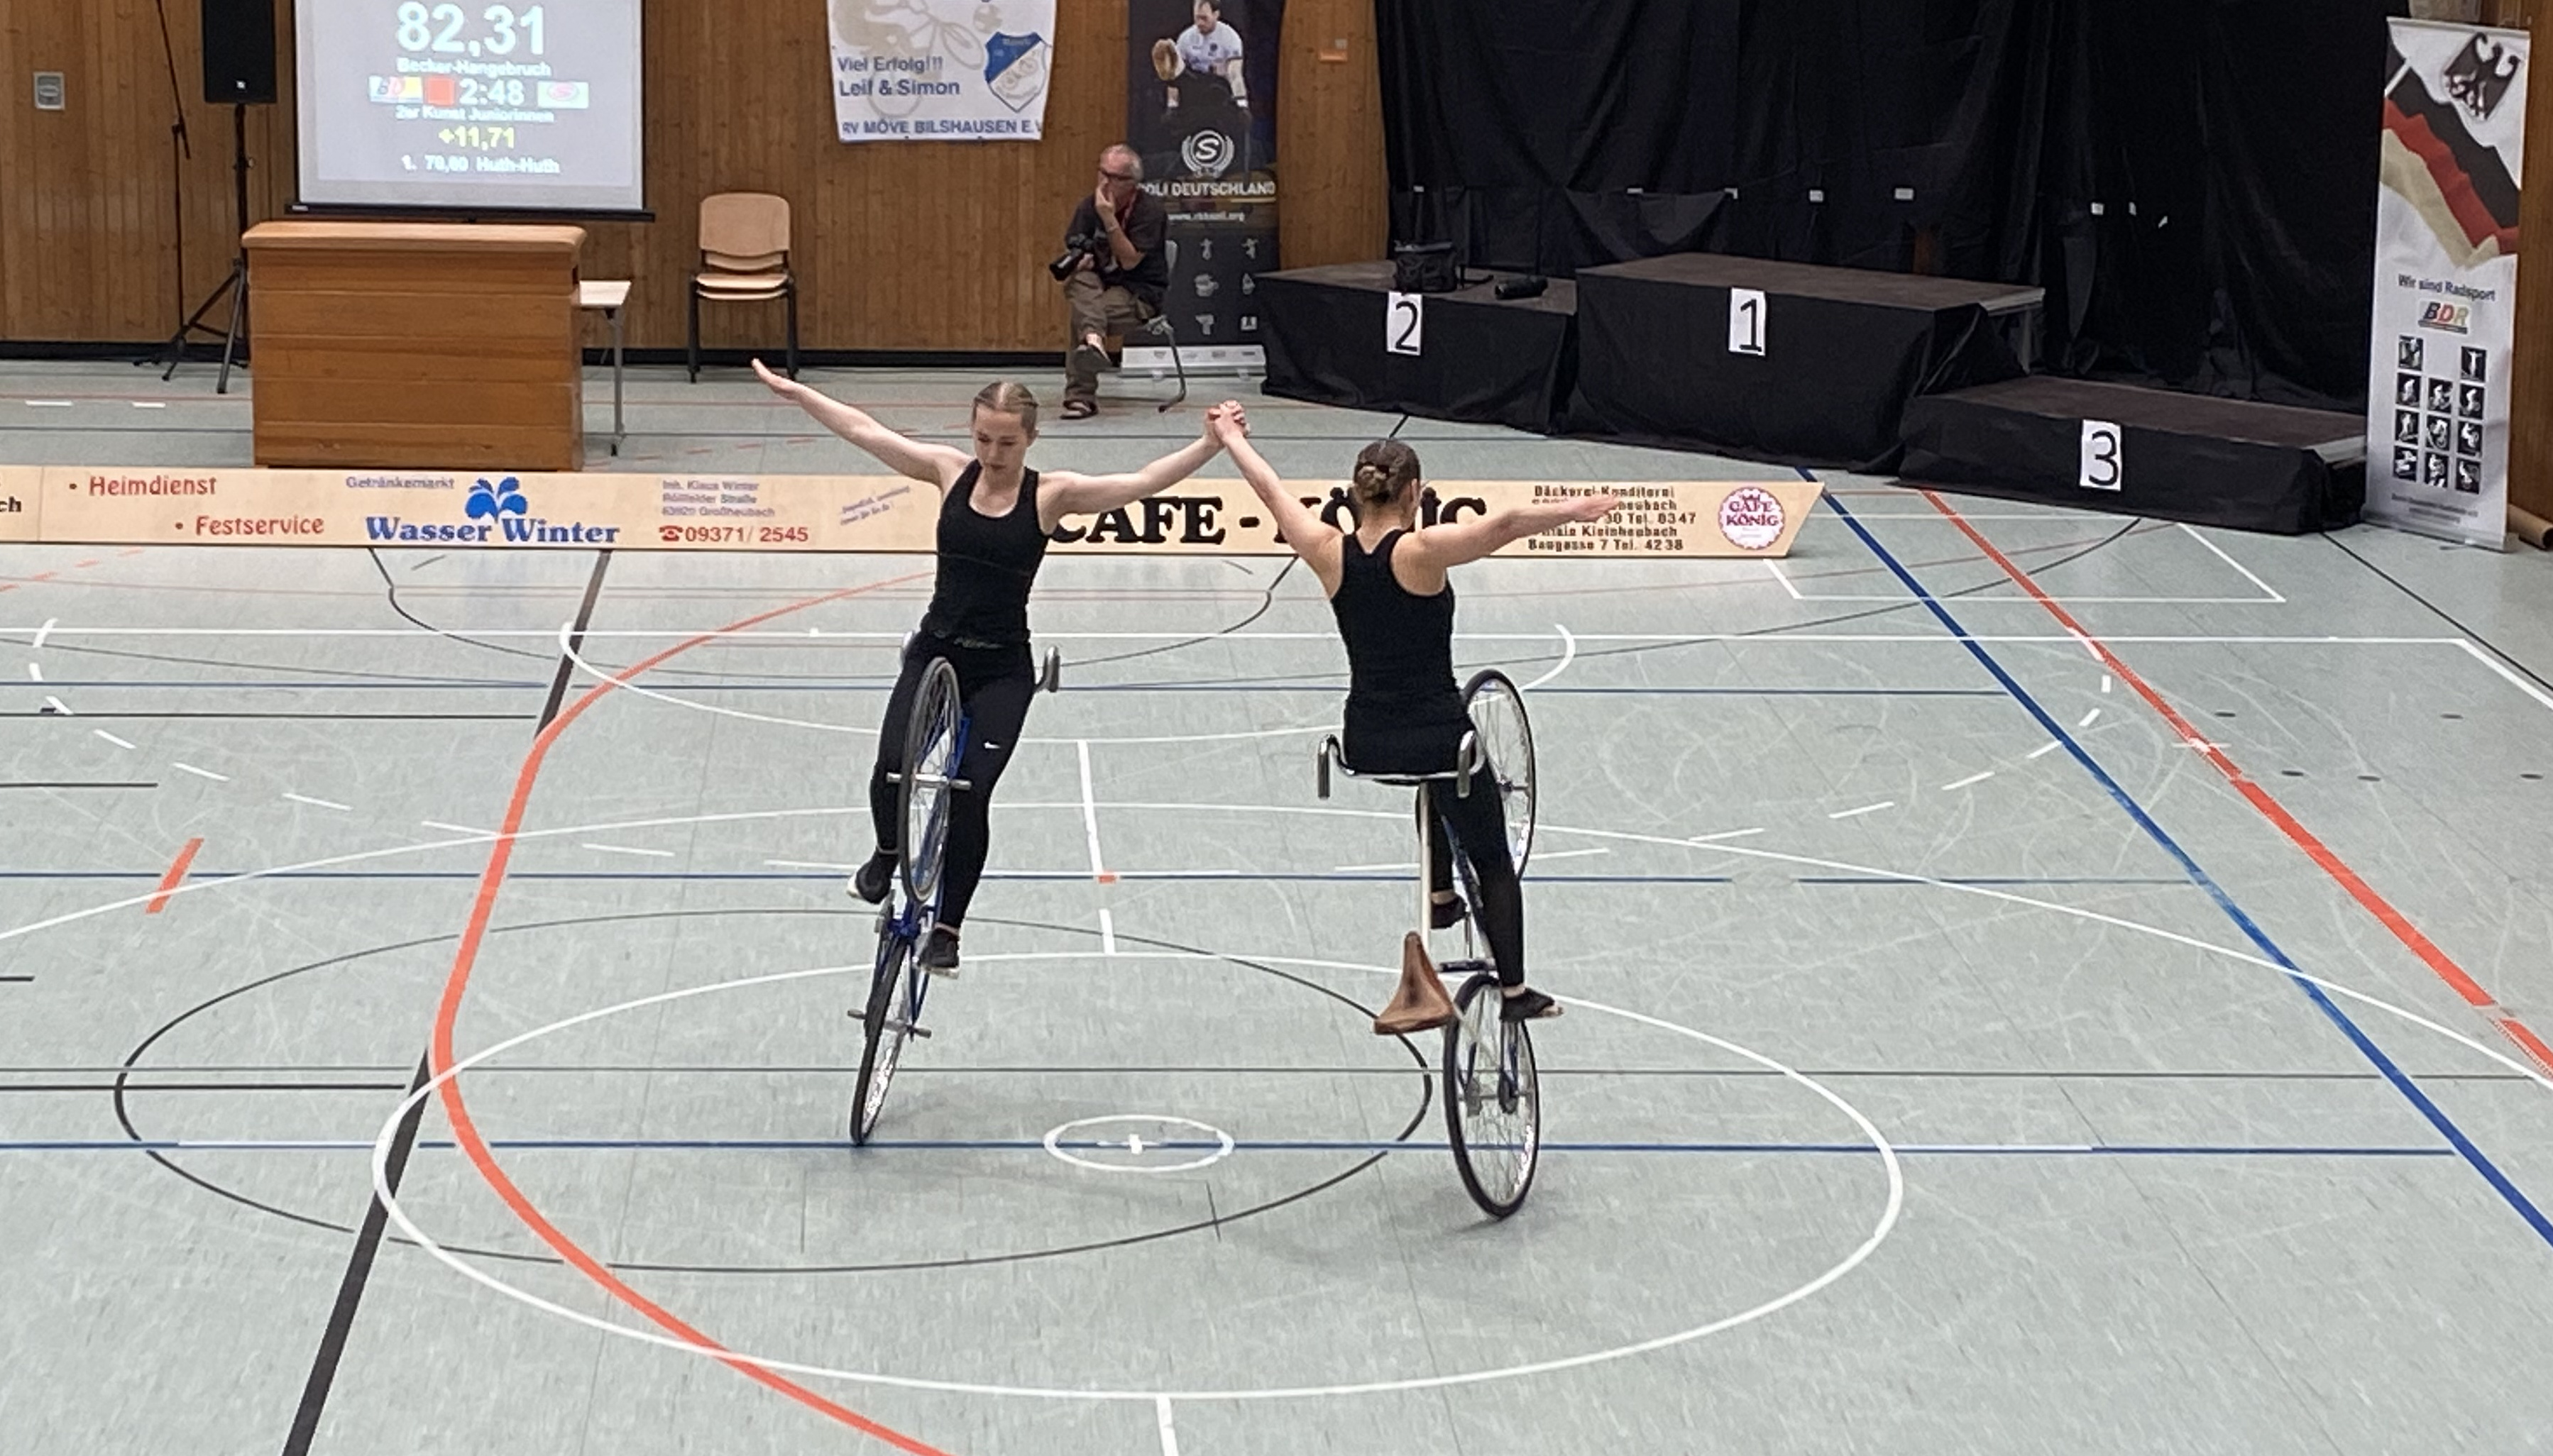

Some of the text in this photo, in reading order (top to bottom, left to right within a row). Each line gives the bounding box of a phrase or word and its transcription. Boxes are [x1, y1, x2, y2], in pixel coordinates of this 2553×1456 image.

[397, 1, 544, 56] 82,31
[838, 56, 943, 74] Viel Erfolg!!!
[459, 78, 525, 105] 2:48
[840, 79, 960, 96] Leif & Simon
[422, 105, 466, 120] Kunst
[468, 109, 554, 123] Juniorinnen
[863, 119, 909, 133] MÖVE
[914, 119, 1017, 134] BILSHAUSEN
[438, 126, 515, 150] +11,71
[402, 155, 417, 170] 1.
[476, 156, 560, 174] Huth-Huth
[1172, 181, 1276, 197] DEUTSCHLAND
[2398, 273, 2495, 302] Wir sind Radsport
[2423, 302, 2469, 326] BDR
[1395, 301, 1418, 352] 2
[1740, 299, 1762, 352] 1
[2089, 430, 2119, 486] 3
[89, 475, 216, 496] Heimdienst
[346, 477, 454, 490] Getränkemarkt
[196, 515, 324, 535] Festservice
[366, 517, 620, 542] Wasser Winter
[1726, 514, 1779, 526] KÖNIG
[759, 526, 808, 542] 2545
[1600, 539, 1608, 551] 7
[1613, 539, 1637, 551] Tel.
[1645, 539, 1684, 551] 4238
